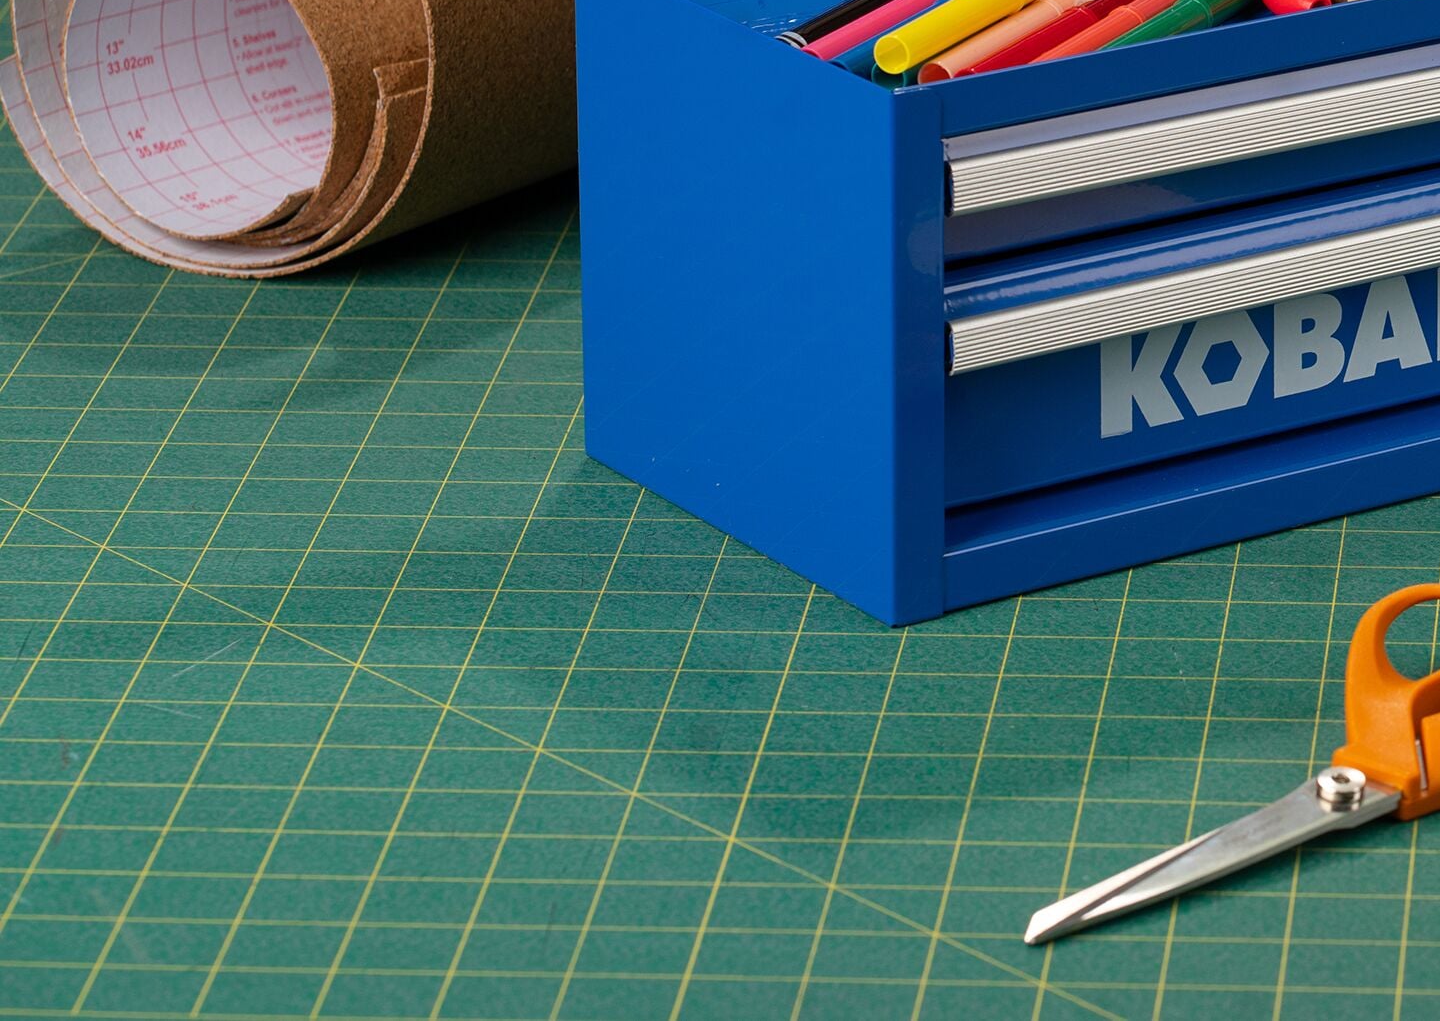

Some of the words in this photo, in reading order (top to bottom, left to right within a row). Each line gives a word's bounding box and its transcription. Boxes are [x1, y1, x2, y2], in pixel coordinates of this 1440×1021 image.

[106, 39, 124, 56] 13"
[107, 54, 154, 75] 33.02cm
[127, 126, 146, 142] 14"
[136, 139, 188, 159] 35.56cm
